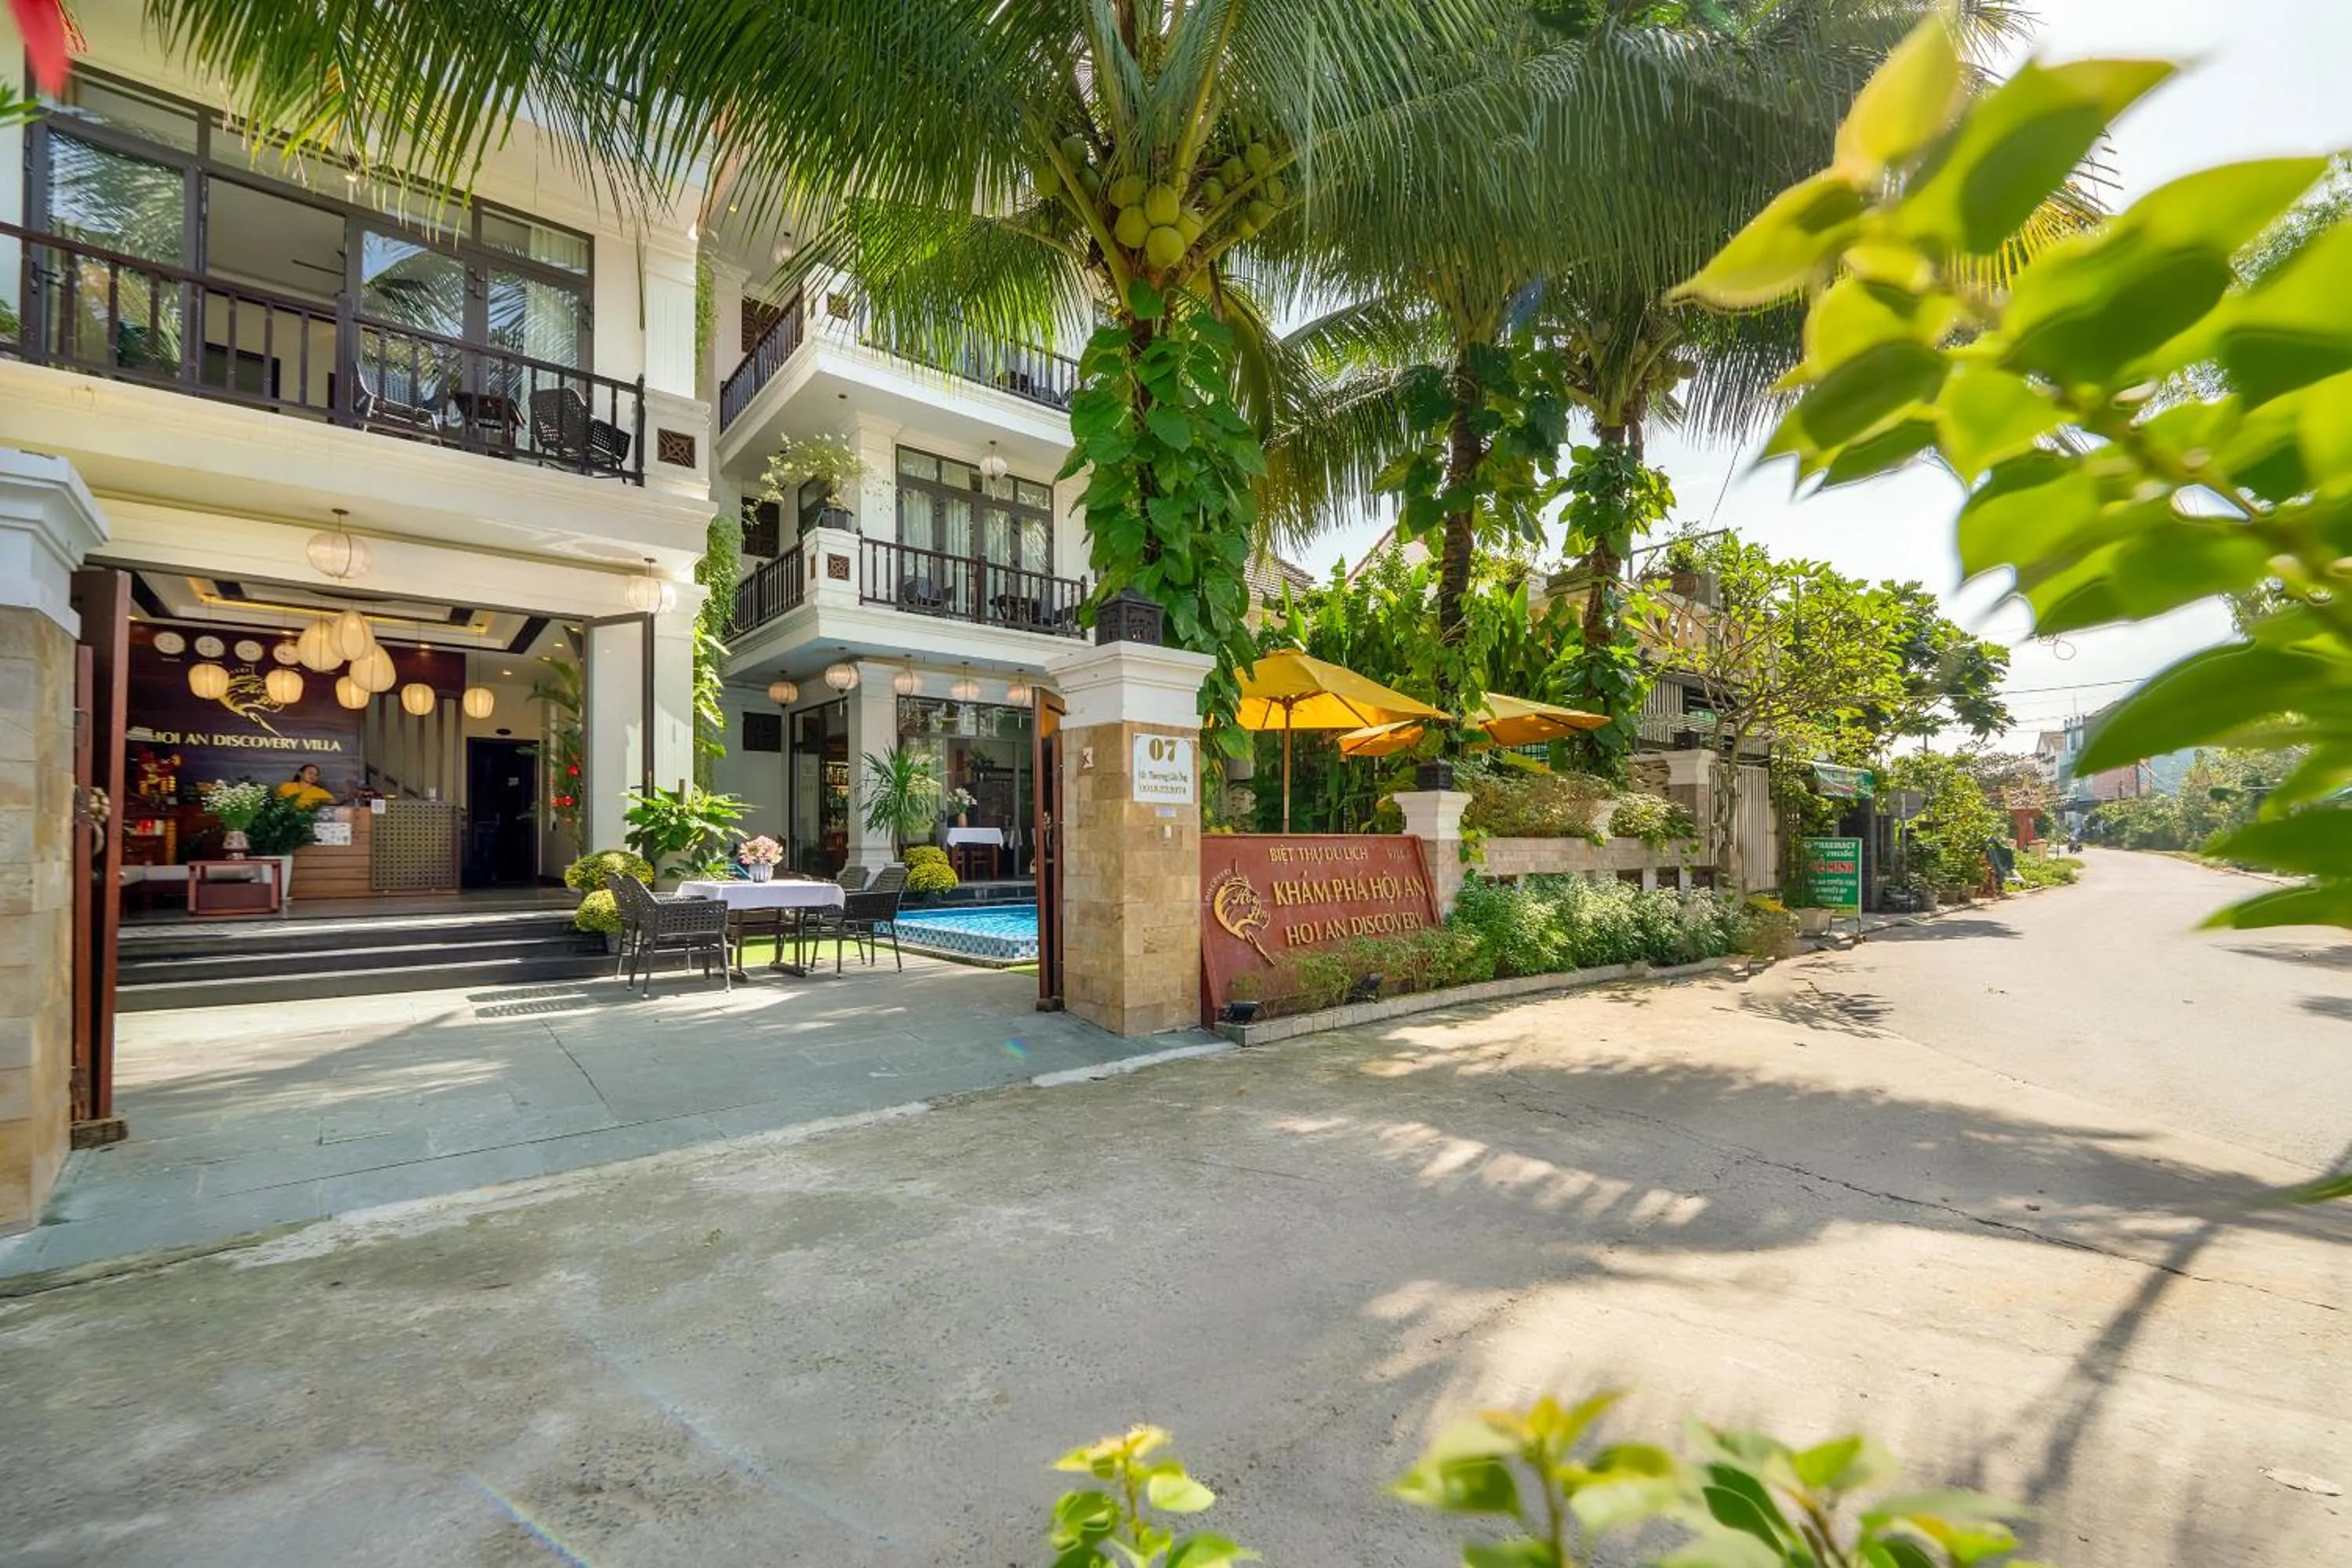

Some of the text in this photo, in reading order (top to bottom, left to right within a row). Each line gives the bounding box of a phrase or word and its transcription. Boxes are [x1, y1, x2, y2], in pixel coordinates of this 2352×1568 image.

[184, 733, 209, 746] AN
[212, 734, 299, 750] DISCOVERY
[303, 738, 341, 752] VILLA
[1149, 738, 1177, 762] 07
[1272, 869, 1426, 906] KHÁM PHÁ HỘI AN
[1285, 912, 1425, 946] HOI AN DISCOVERY
